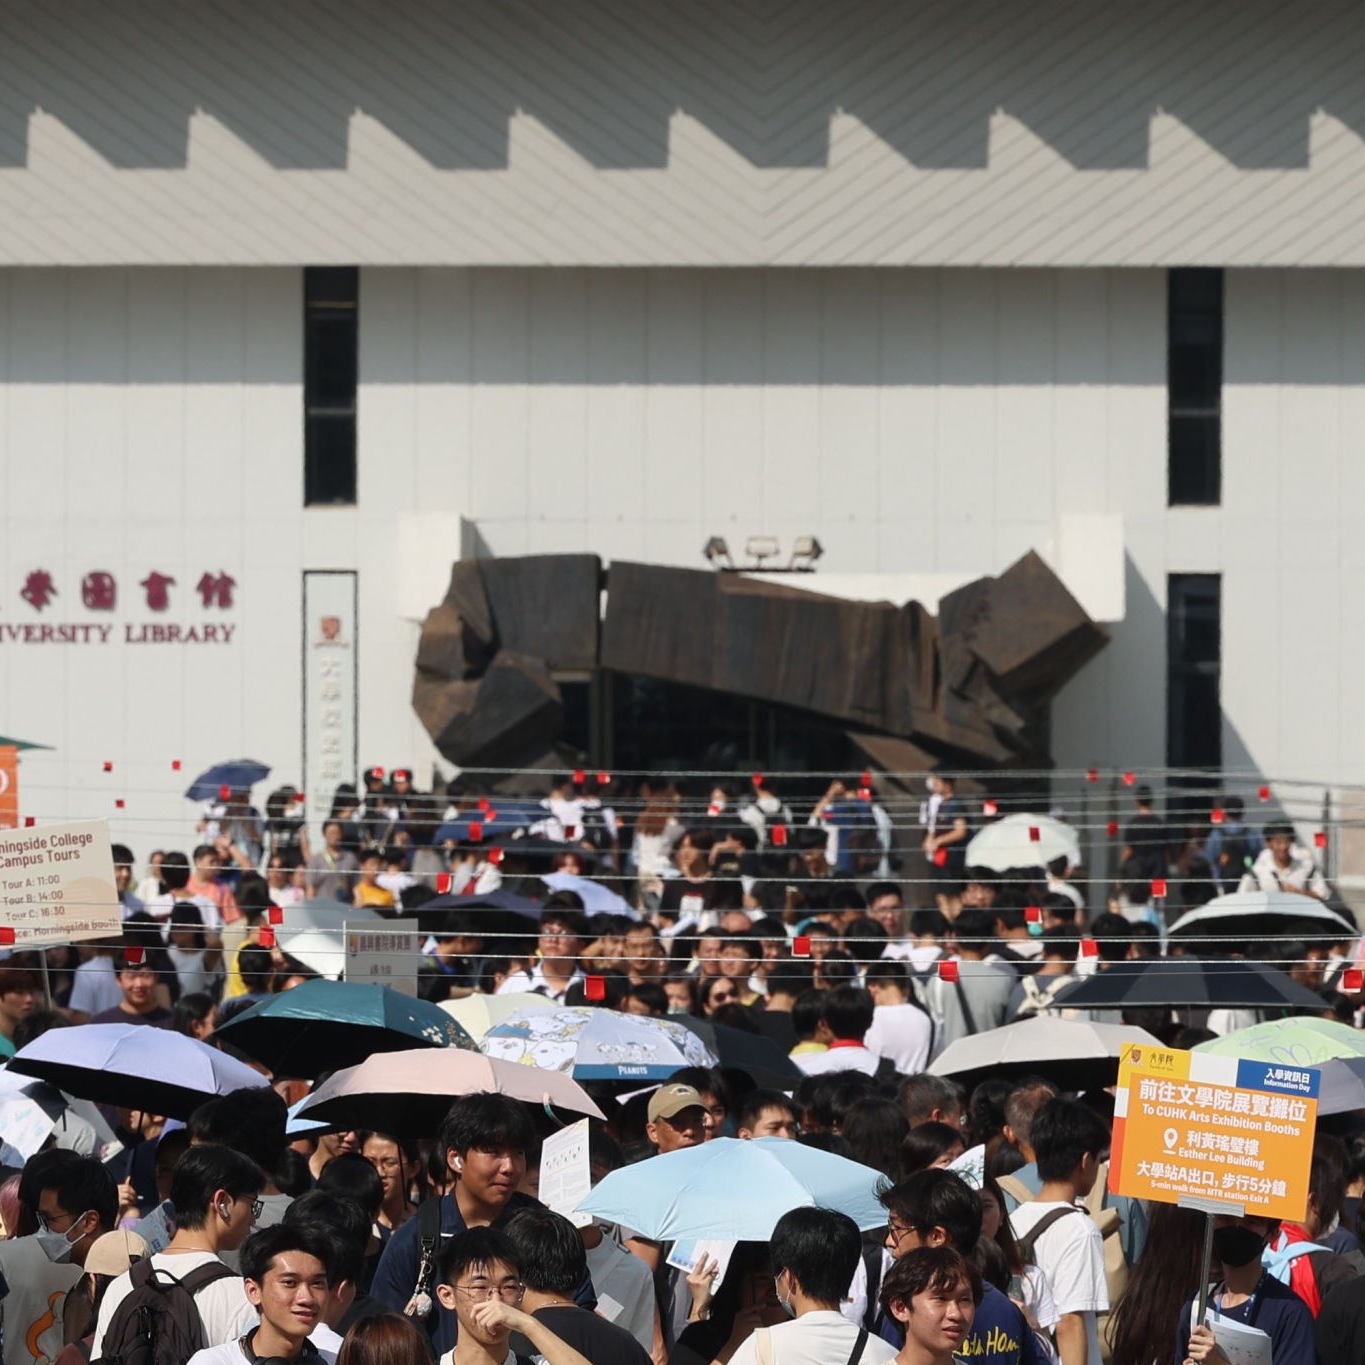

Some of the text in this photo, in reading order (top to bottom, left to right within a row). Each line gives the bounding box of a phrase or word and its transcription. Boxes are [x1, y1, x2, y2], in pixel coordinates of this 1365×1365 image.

[125, 623, 236, 643] LIBRARY
[50, 833, 93, 850] College
[47, 849, 81, 864] Tours
[2, 880, 24, 891] Tour
[36, 874, 60, 886] 11:00
[37, 890, 64, 902] 14:00
[40, 905, 66, 918] 16:30
[34, 921, 90, 936] Morningside
[1265, 1067, 1310, 1083] 入學資訊日
[1263, 1079, 1311, 1093] Information Day
[1139, 1079, 1308, 1122] 前往文學院展覽攤位
[1142, 1103, 1300, 1137] To CUHK Arts Exhibition Booths
[1178, 1148, 1265, 1171] Esther Lee Building
[1151, 1180, 1270, 1204] 5-min walk from MTR station Exit A
